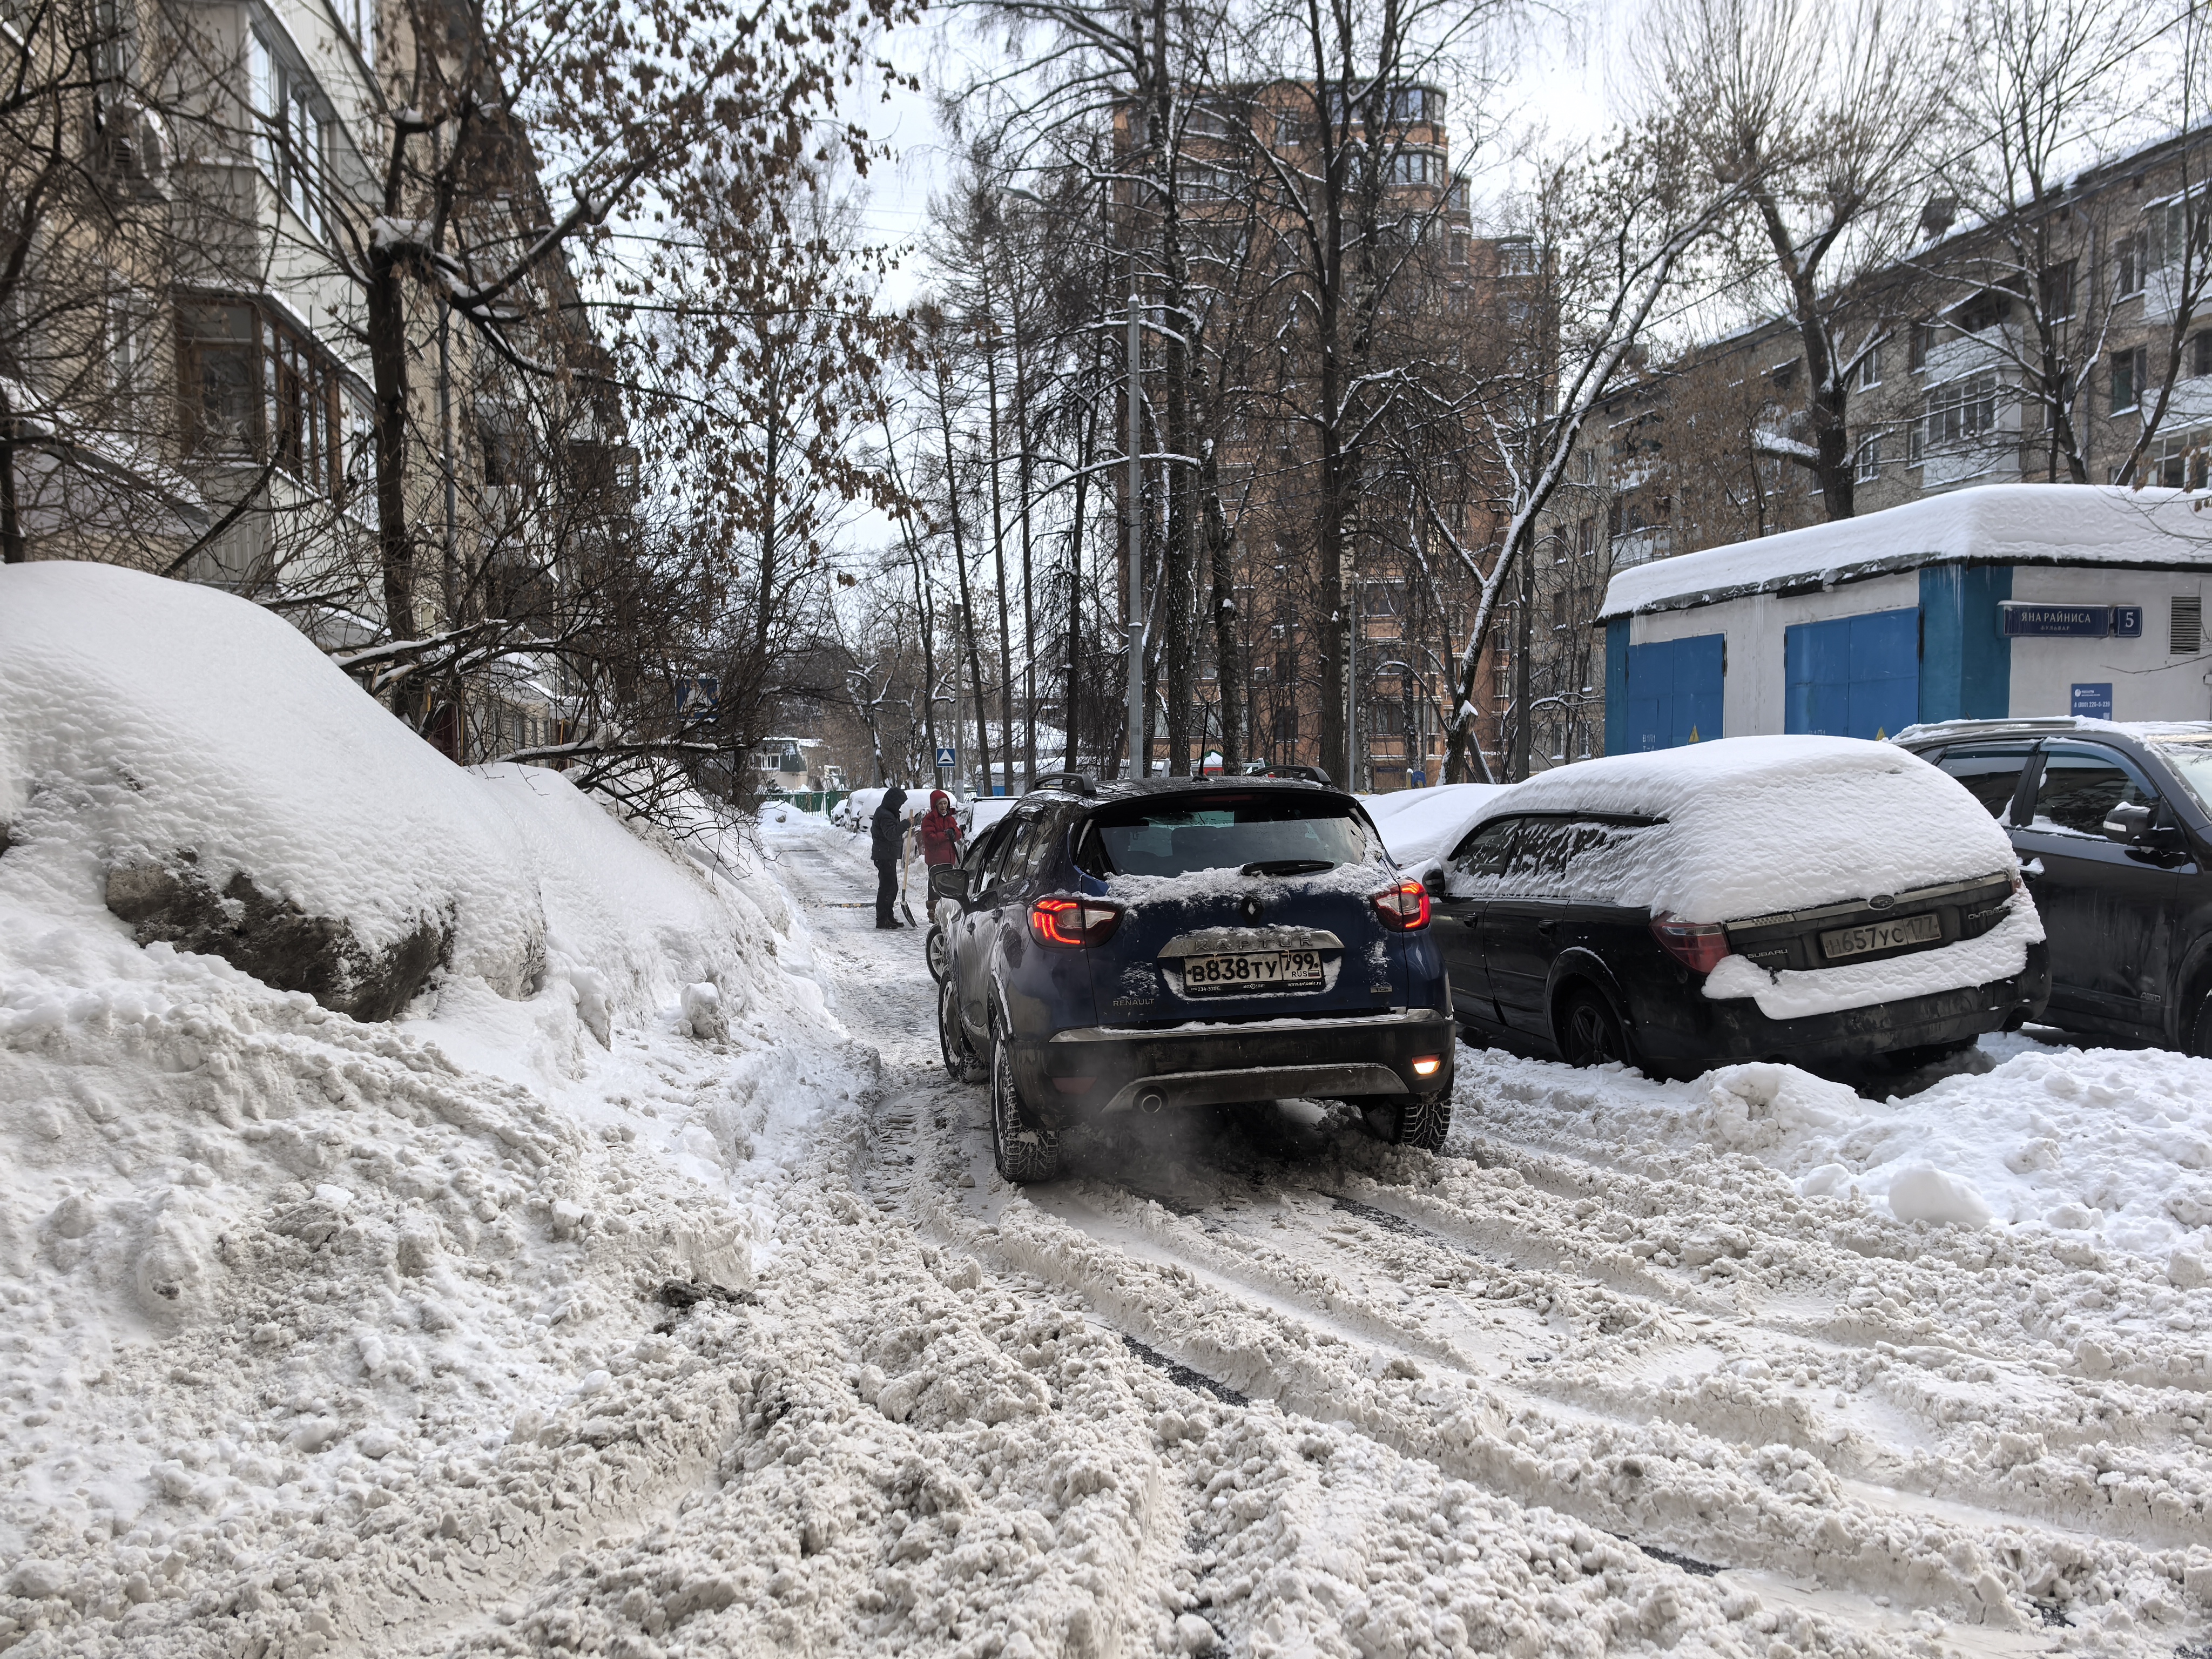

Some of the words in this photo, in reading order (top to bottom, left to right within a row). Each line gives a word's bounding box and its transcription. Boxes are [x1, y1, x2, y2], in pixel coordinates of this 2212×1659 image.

[2021, 612, 2041, 622] ЯНА
[2044, 611, 2091, 623] РАЙНИСА
[2125, 611, 2134, 628] 5
[1830, 927, 1904, 954] Н657УС
[1906, 916, 1933, 937] 177
[1195, 936, 1313, 951] KAPTUR
[1748, 949, 1788, 959] SUBARU
[1192, 958, 1277, 982] В838ТУ
[1282, 953, 1314, 971] 799
[1113, 998, 1155, 1006] RENAULT
